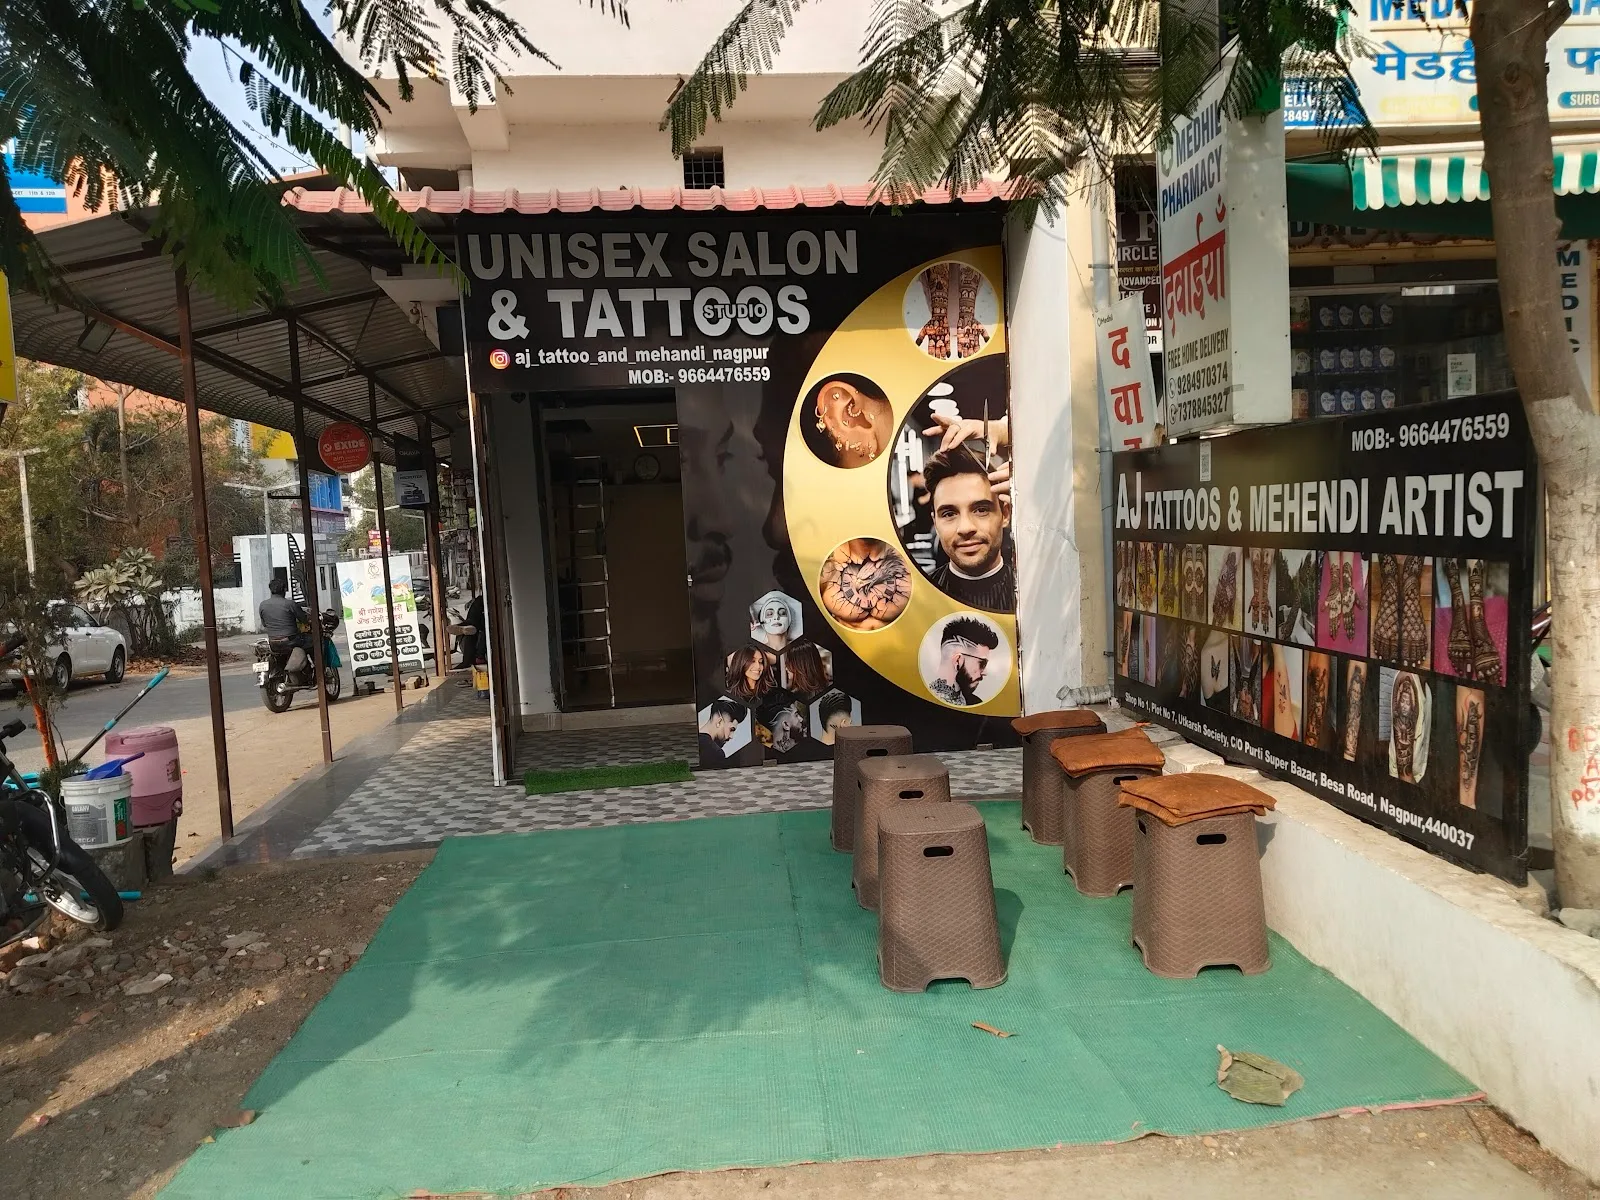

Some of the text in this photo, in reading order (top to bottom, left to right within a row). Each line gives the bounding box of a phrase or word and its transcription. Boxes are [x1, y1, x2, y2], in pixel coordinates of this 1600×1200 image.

[1176, 100, 1222, 167] MEDHIL
[1162, 144, 1222, 222] PHARMACY
[467, 229, 858, 280] UNISEX SALON
[487, 284, 811, 340] & TATTOOS
[703, 303, 767, 319] STUDIO
[515, 344, 770, 368] aj_tattoo_and_mehandi_nagpur
[1168, 327, 1229, 371] FREE HOME DELIVERY
[628, 366, 771, 385] MOB:- 9664476559
[1177, 361, 1228, 396] 9284970374
[1178, 388, 1230, 422] 7378845327
[334, 439, 365, 450] EXIDE
[1351, 412, 1511, 452] MOB:- 9664476559
[1116, 470, 1524, 539] AJ TATTOOS & MEHENDI ARTIST
[1125, 692, 1137, 708] Shop
[1137, 697, 1146, 709] No
[1146, 701, 1151, 713] 1,
[1151, 703, 1163, 718] Plot
[1163, 707, 1171, 720] No
[1171, 710, 1178, 725] 7,
[1178, 713, 1202, 734] Utkarsh
[1203, 724, 1229, 748] Society,
[1231, 736, 1243, 751] C/O
[1244, 741, 1264, 761] Purti
[1265, 749, 1290, 771] Super
[1290, 759, 1318, 787] Bazar,
[1320, 772, 1344, 796] Besa
[1347, 783, 1377, 812] Road,
